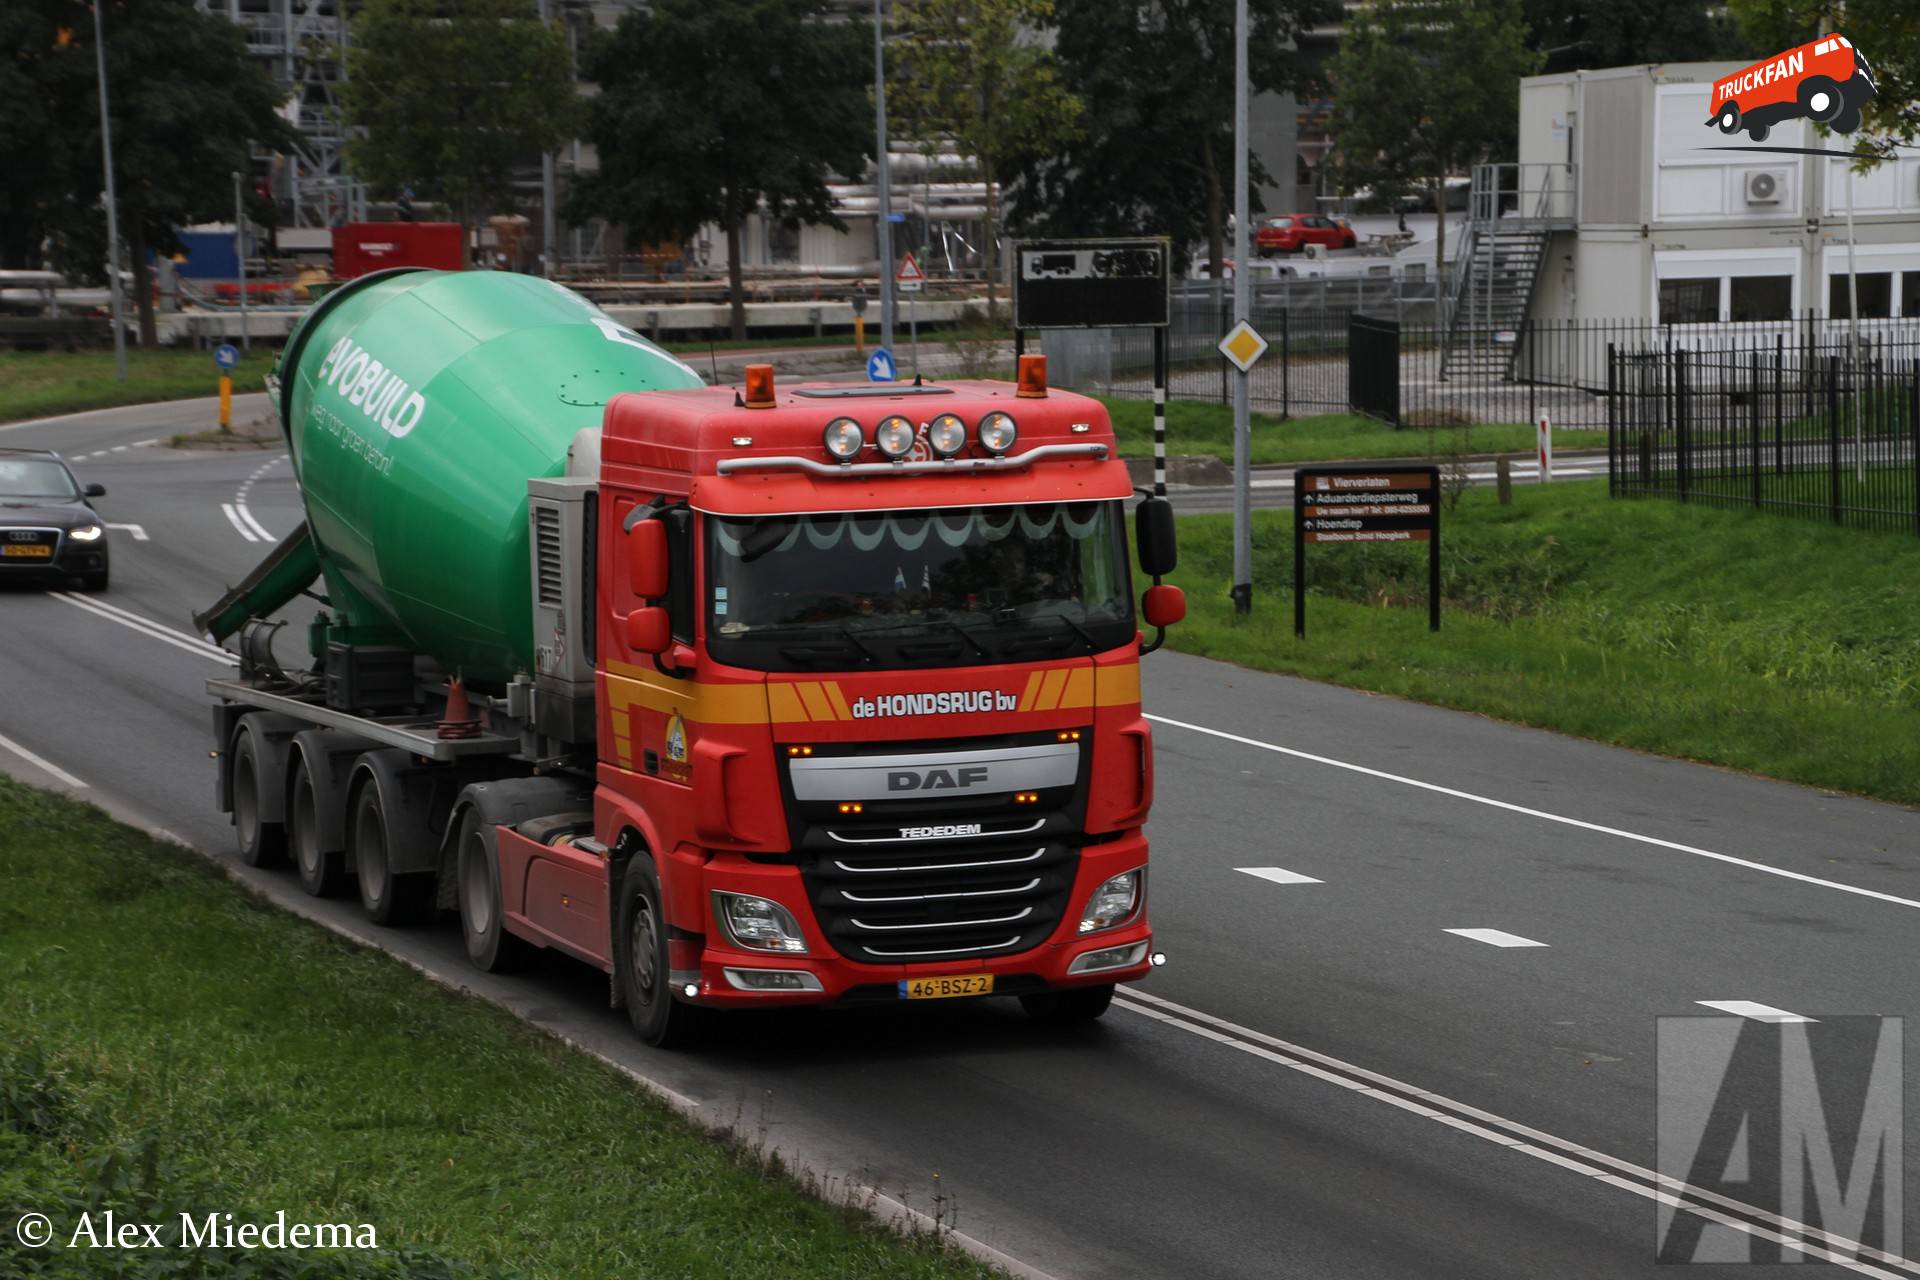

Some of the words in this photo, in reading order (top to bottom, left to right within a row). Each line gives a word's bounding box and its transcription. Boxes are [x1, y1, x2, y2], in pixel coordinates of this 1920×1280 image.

[1333, 478, 1391, 488] Vierverlaten
[1316, 493, 1418, 504] Aduarderdiepsterweg
[1316, 519, 1363, 530] Hoendiep
[852, 696, 876, 719] de
[876, 690, 993, 718] HONDSRUG
[995, 690, 1017, 711] bv
[888, 767, 988, 791] DAF
[899, 823, 981, 838] TEDEDEM
[913, 977, 988, 996] 46-BSZ-2
